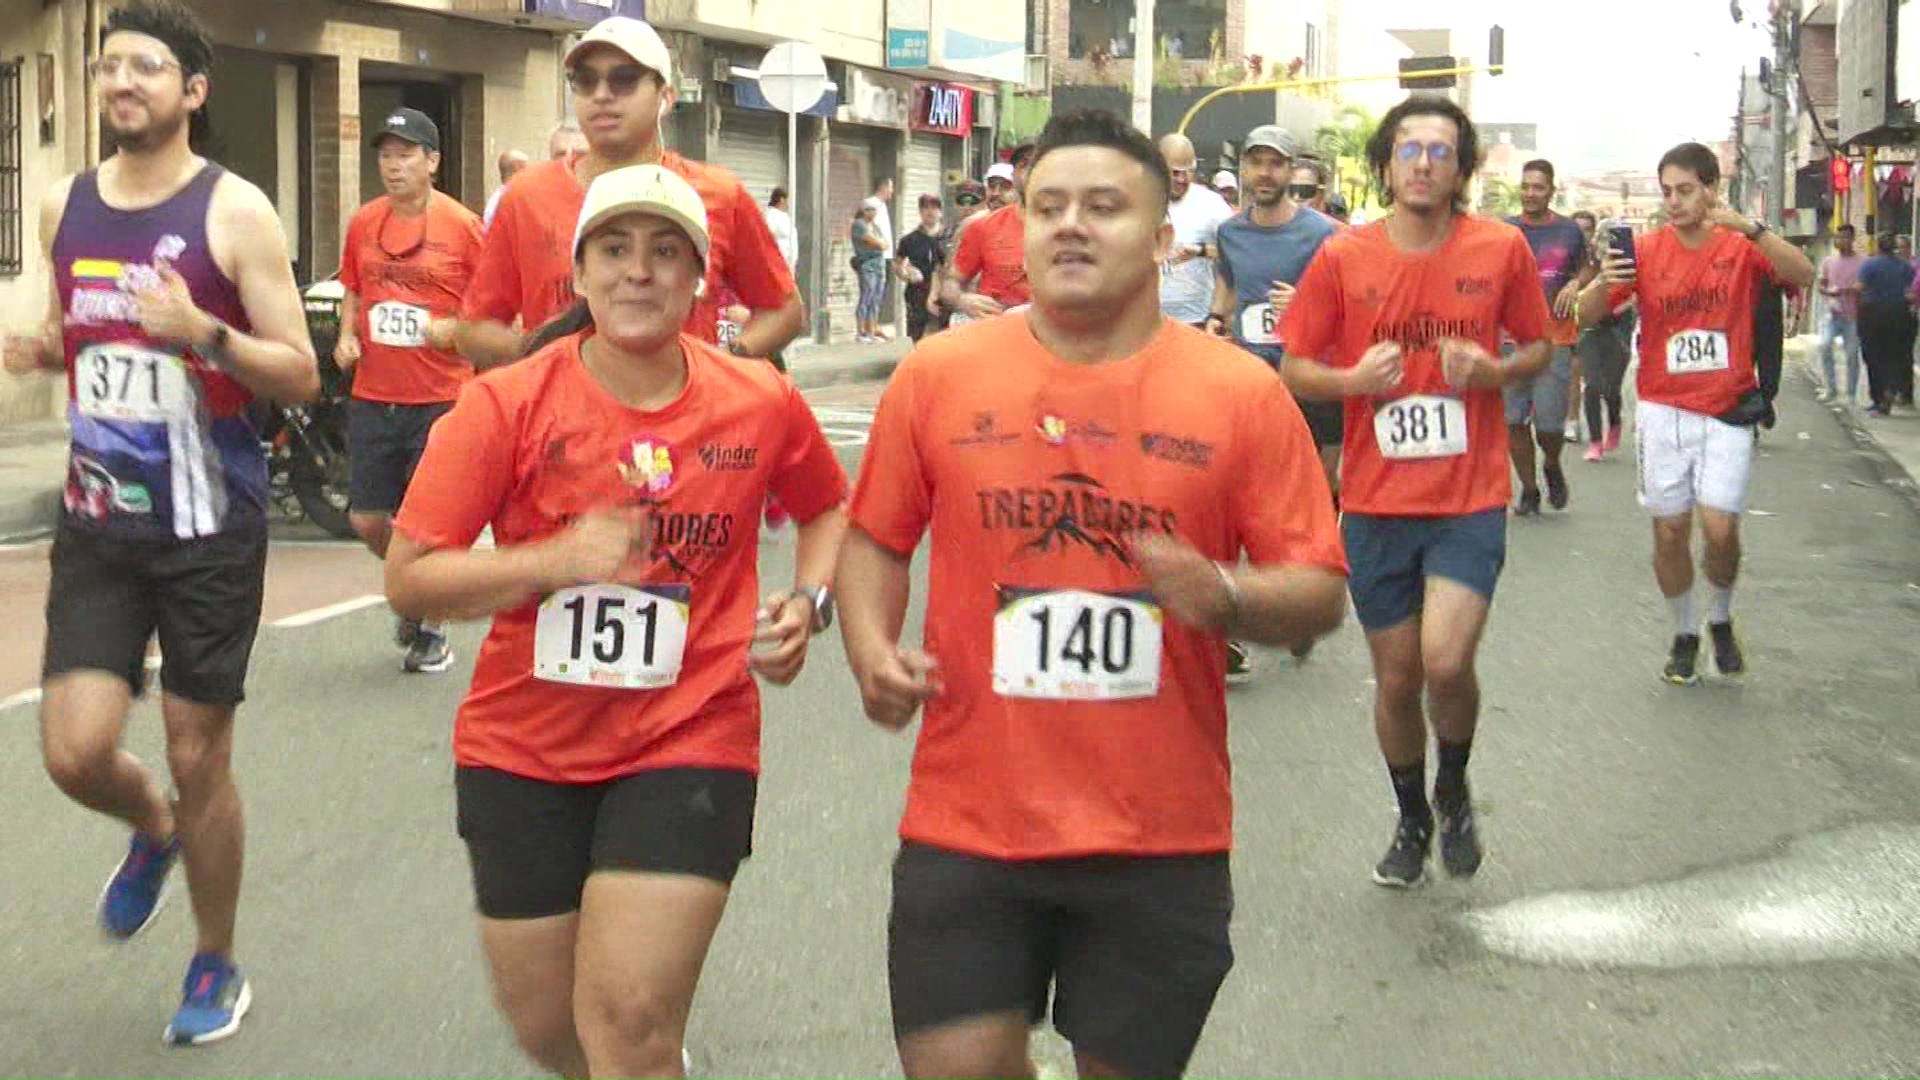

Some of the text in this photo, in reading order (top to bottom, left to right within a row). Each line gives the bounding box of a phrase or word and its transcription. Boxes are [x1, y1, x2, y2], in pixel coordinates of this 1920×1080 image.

[378, 306, 418, 341] 255
[1674, 333, 1717, 363] 284
[91, 353, 160, 403] 371
[1388, 401, 1449, 444] 381
[976, 488, 1177, 536] TREPADORES
[563, 595, 658, 668] 151
[1030, 606, 1133, 674] 140
